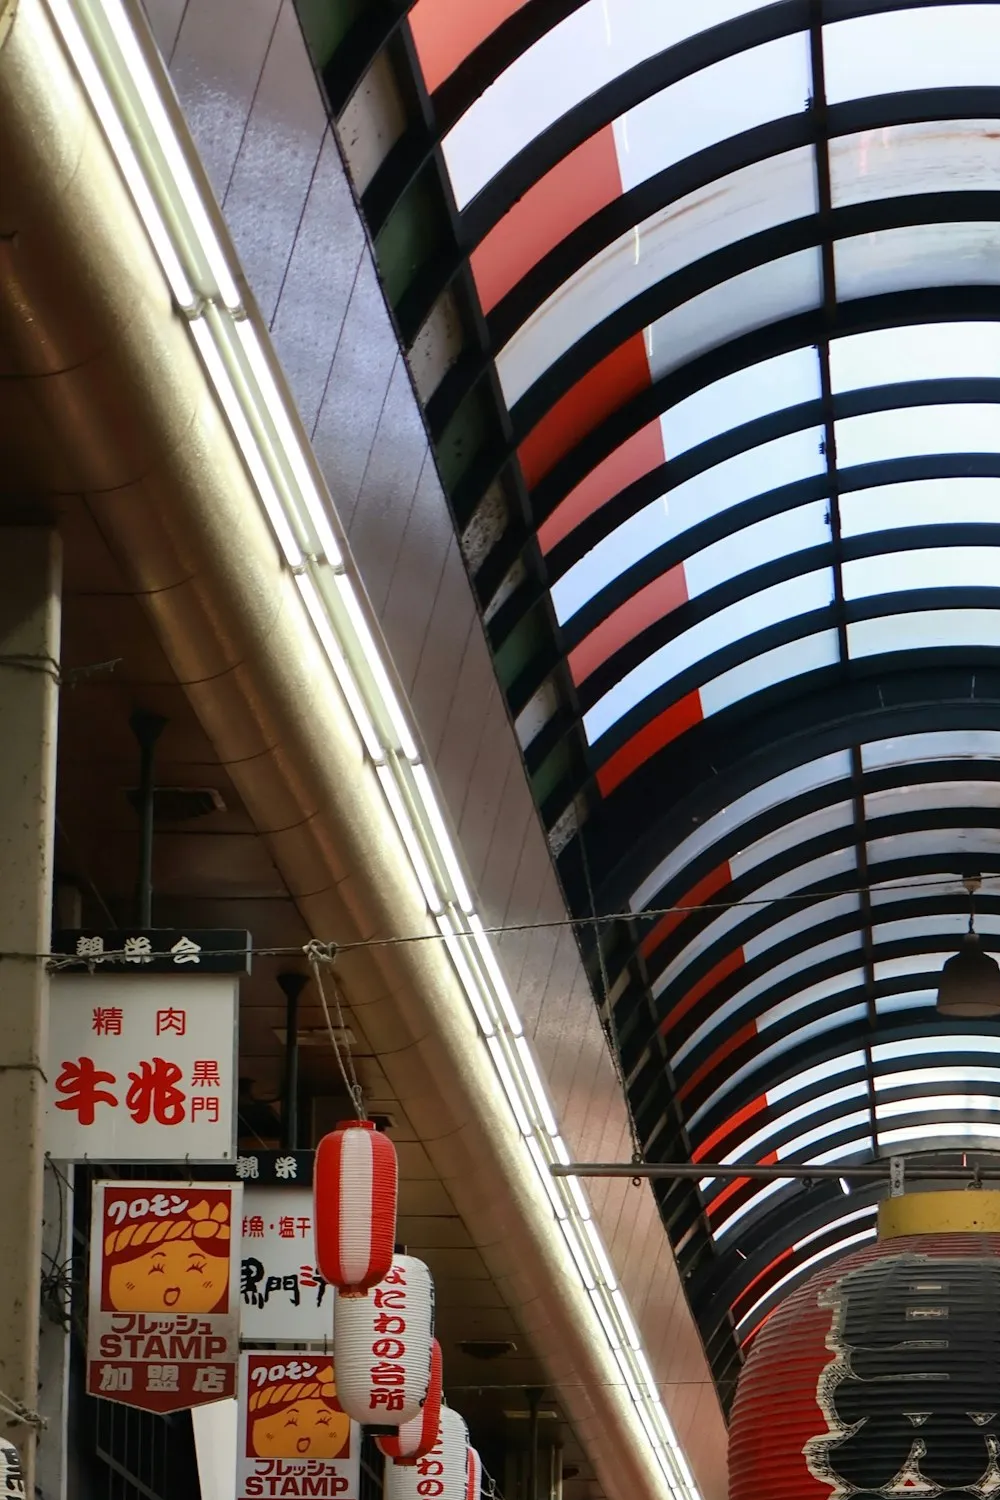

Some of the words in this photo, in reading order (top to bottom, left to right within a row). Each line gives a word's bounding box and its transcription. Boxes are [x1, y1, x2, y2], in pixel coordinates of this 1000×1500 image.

[76, 936, 201, 964] 親栄会
[92, 1007, 186, 1036] 精肉
[191, 1061, 220, 1123] 黒門
[107, 1194, 189, 1225] クロモン
[111, 1313, 213, 1335] フレッシュ
[369, 1265, 406, 1411] なにわの台所
[100, 1335, 227, 1360] STAMP
[99, 1363, 227, 1393] 加盟店
[250, 1361, 318, 1387] クロモン
[254, 1459, 338, 1476] フレッシュ
[245, 1476, 349, 1496] STAMP
